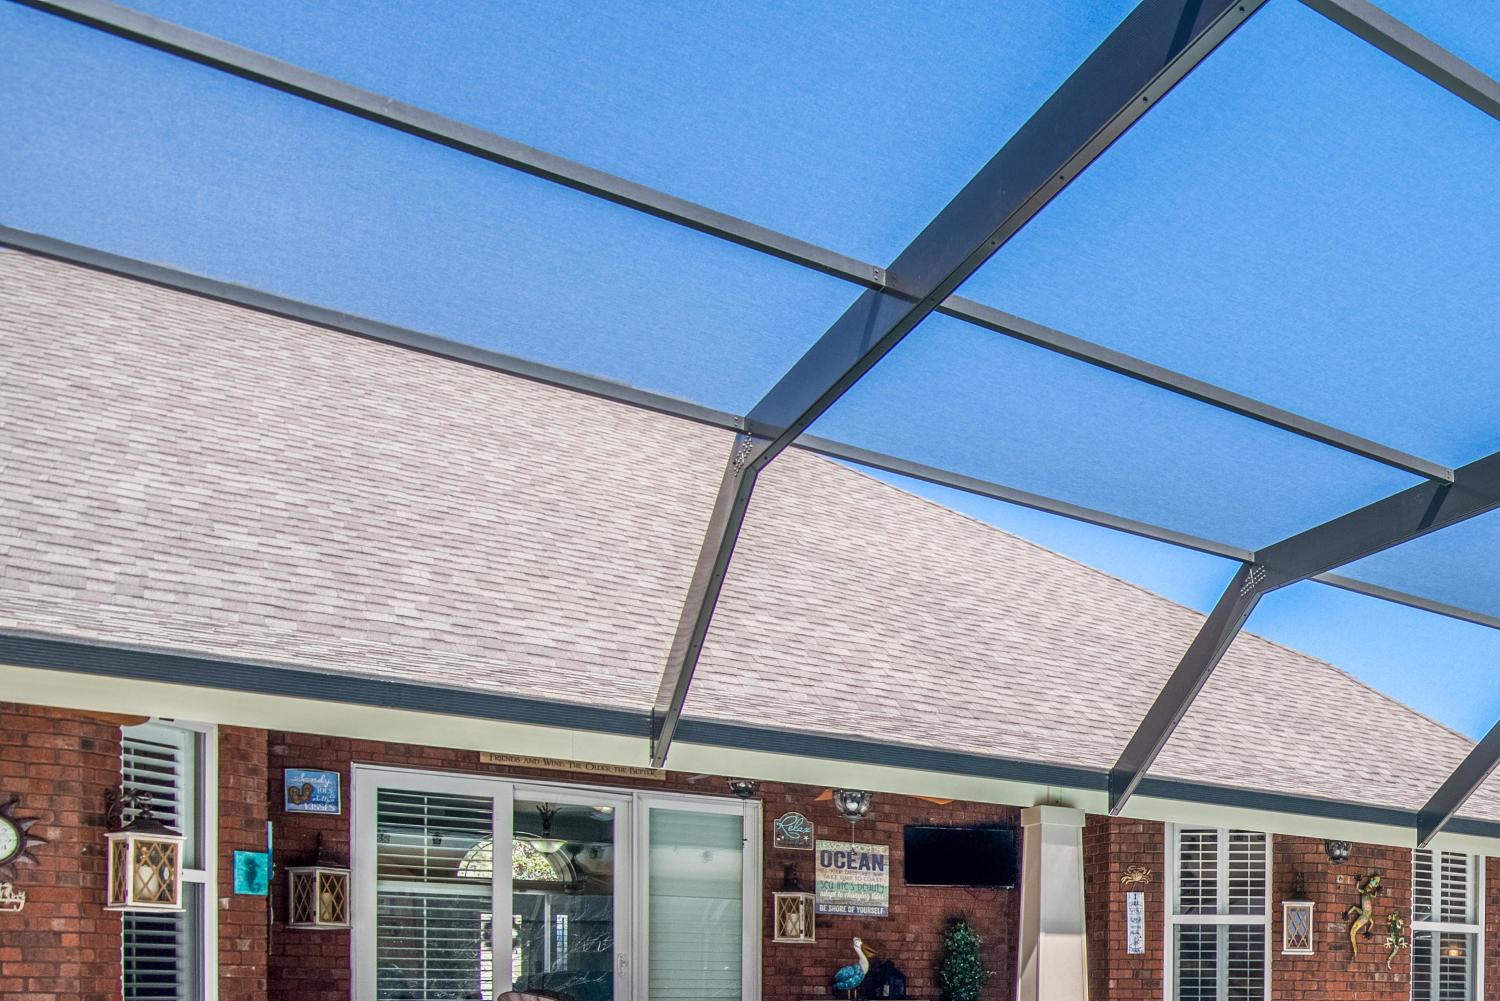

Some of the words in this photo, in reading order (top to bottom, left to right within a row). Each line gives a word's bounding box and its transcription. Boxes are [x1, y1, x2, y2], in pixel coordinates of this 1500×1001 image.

[776, 815, 812, 839] Relax
[820, 850, 884, 871] OCEAN
[819, 904, 828, 912] BE
[828, 904, 847, 913] SHORE
[847, 905, 856, 913] OF
[856, 906, 884, 915] YOURSELF
